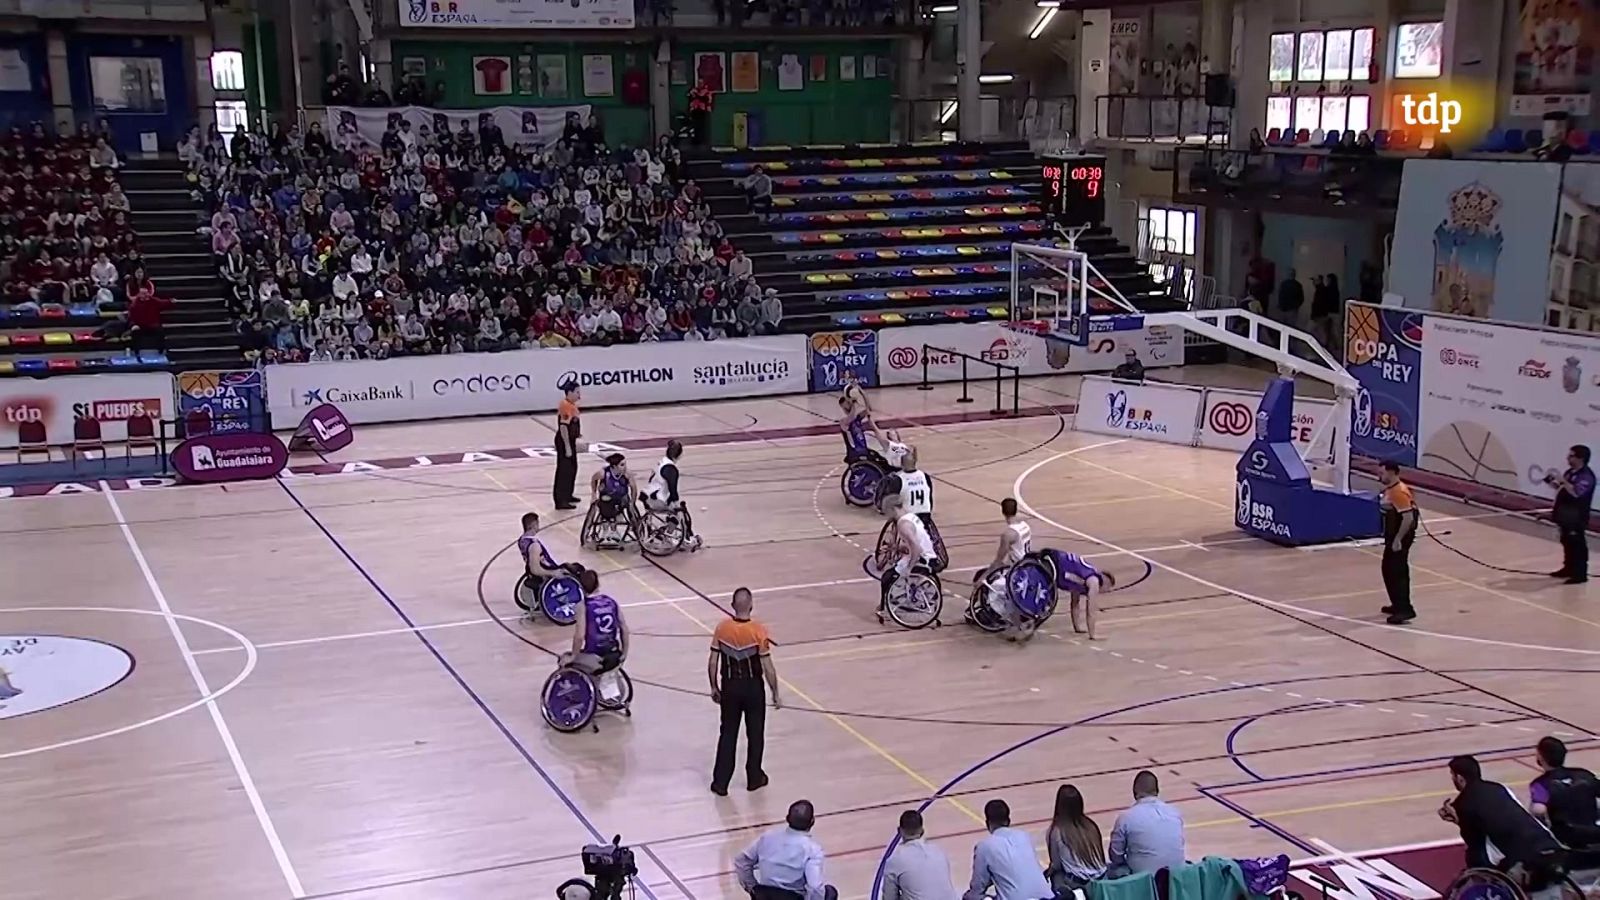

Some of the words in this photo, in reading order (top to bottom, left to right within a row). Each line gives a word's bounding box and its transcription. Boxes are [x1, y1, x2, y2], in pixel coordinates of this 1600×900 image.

[1052, 181, 1060, 197] 9
[1087, 181, 1098, 197] 9
[820, 345, 856, 357] COPA
[1354, 338, 1398, 361] COPA
[693, 357, 788, 378] santalucía
[844, 354, 867, 367] REY
[581, 367, 673, 386] DECATHLON
[1383, 361, 1412, 383] REY
[191, 386, 236, 399] COPA
[433, 373, 531, 396] endesa
[326, 385, 403, 402] CaixaBank
[217, 454, 273, 468] Guadalajara
[910, 489, 924, 506] 14
[1252, 502, 1274, 521] BSR
